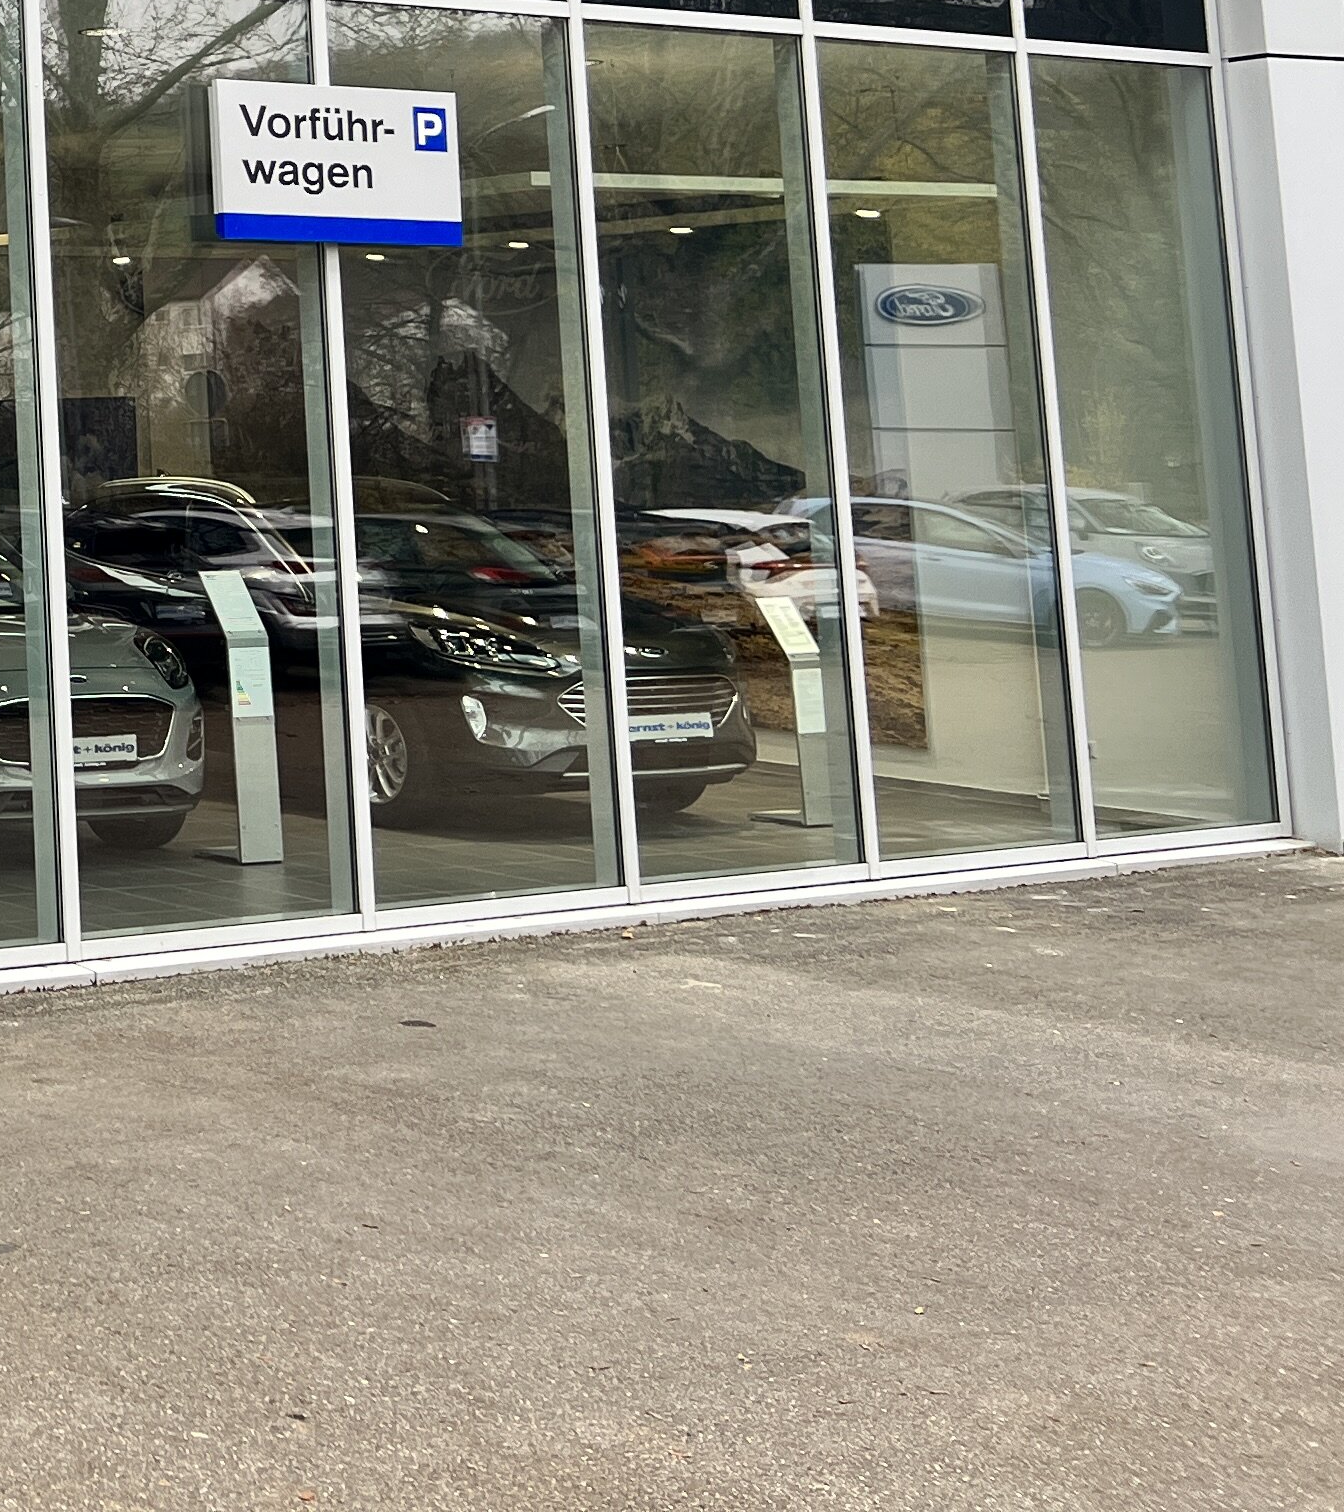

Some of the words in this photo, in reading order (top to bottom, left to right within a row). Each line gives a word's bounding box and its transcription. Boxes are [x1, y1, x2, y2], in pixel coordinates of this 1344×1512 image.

[238, 103, 396, 143] Vorführ-
[417, 112, 443, 146] P
[241, 159, 374, 196] wagen
[676, 720, 711, 731] könig
[94, 742, 135, 753] könig
